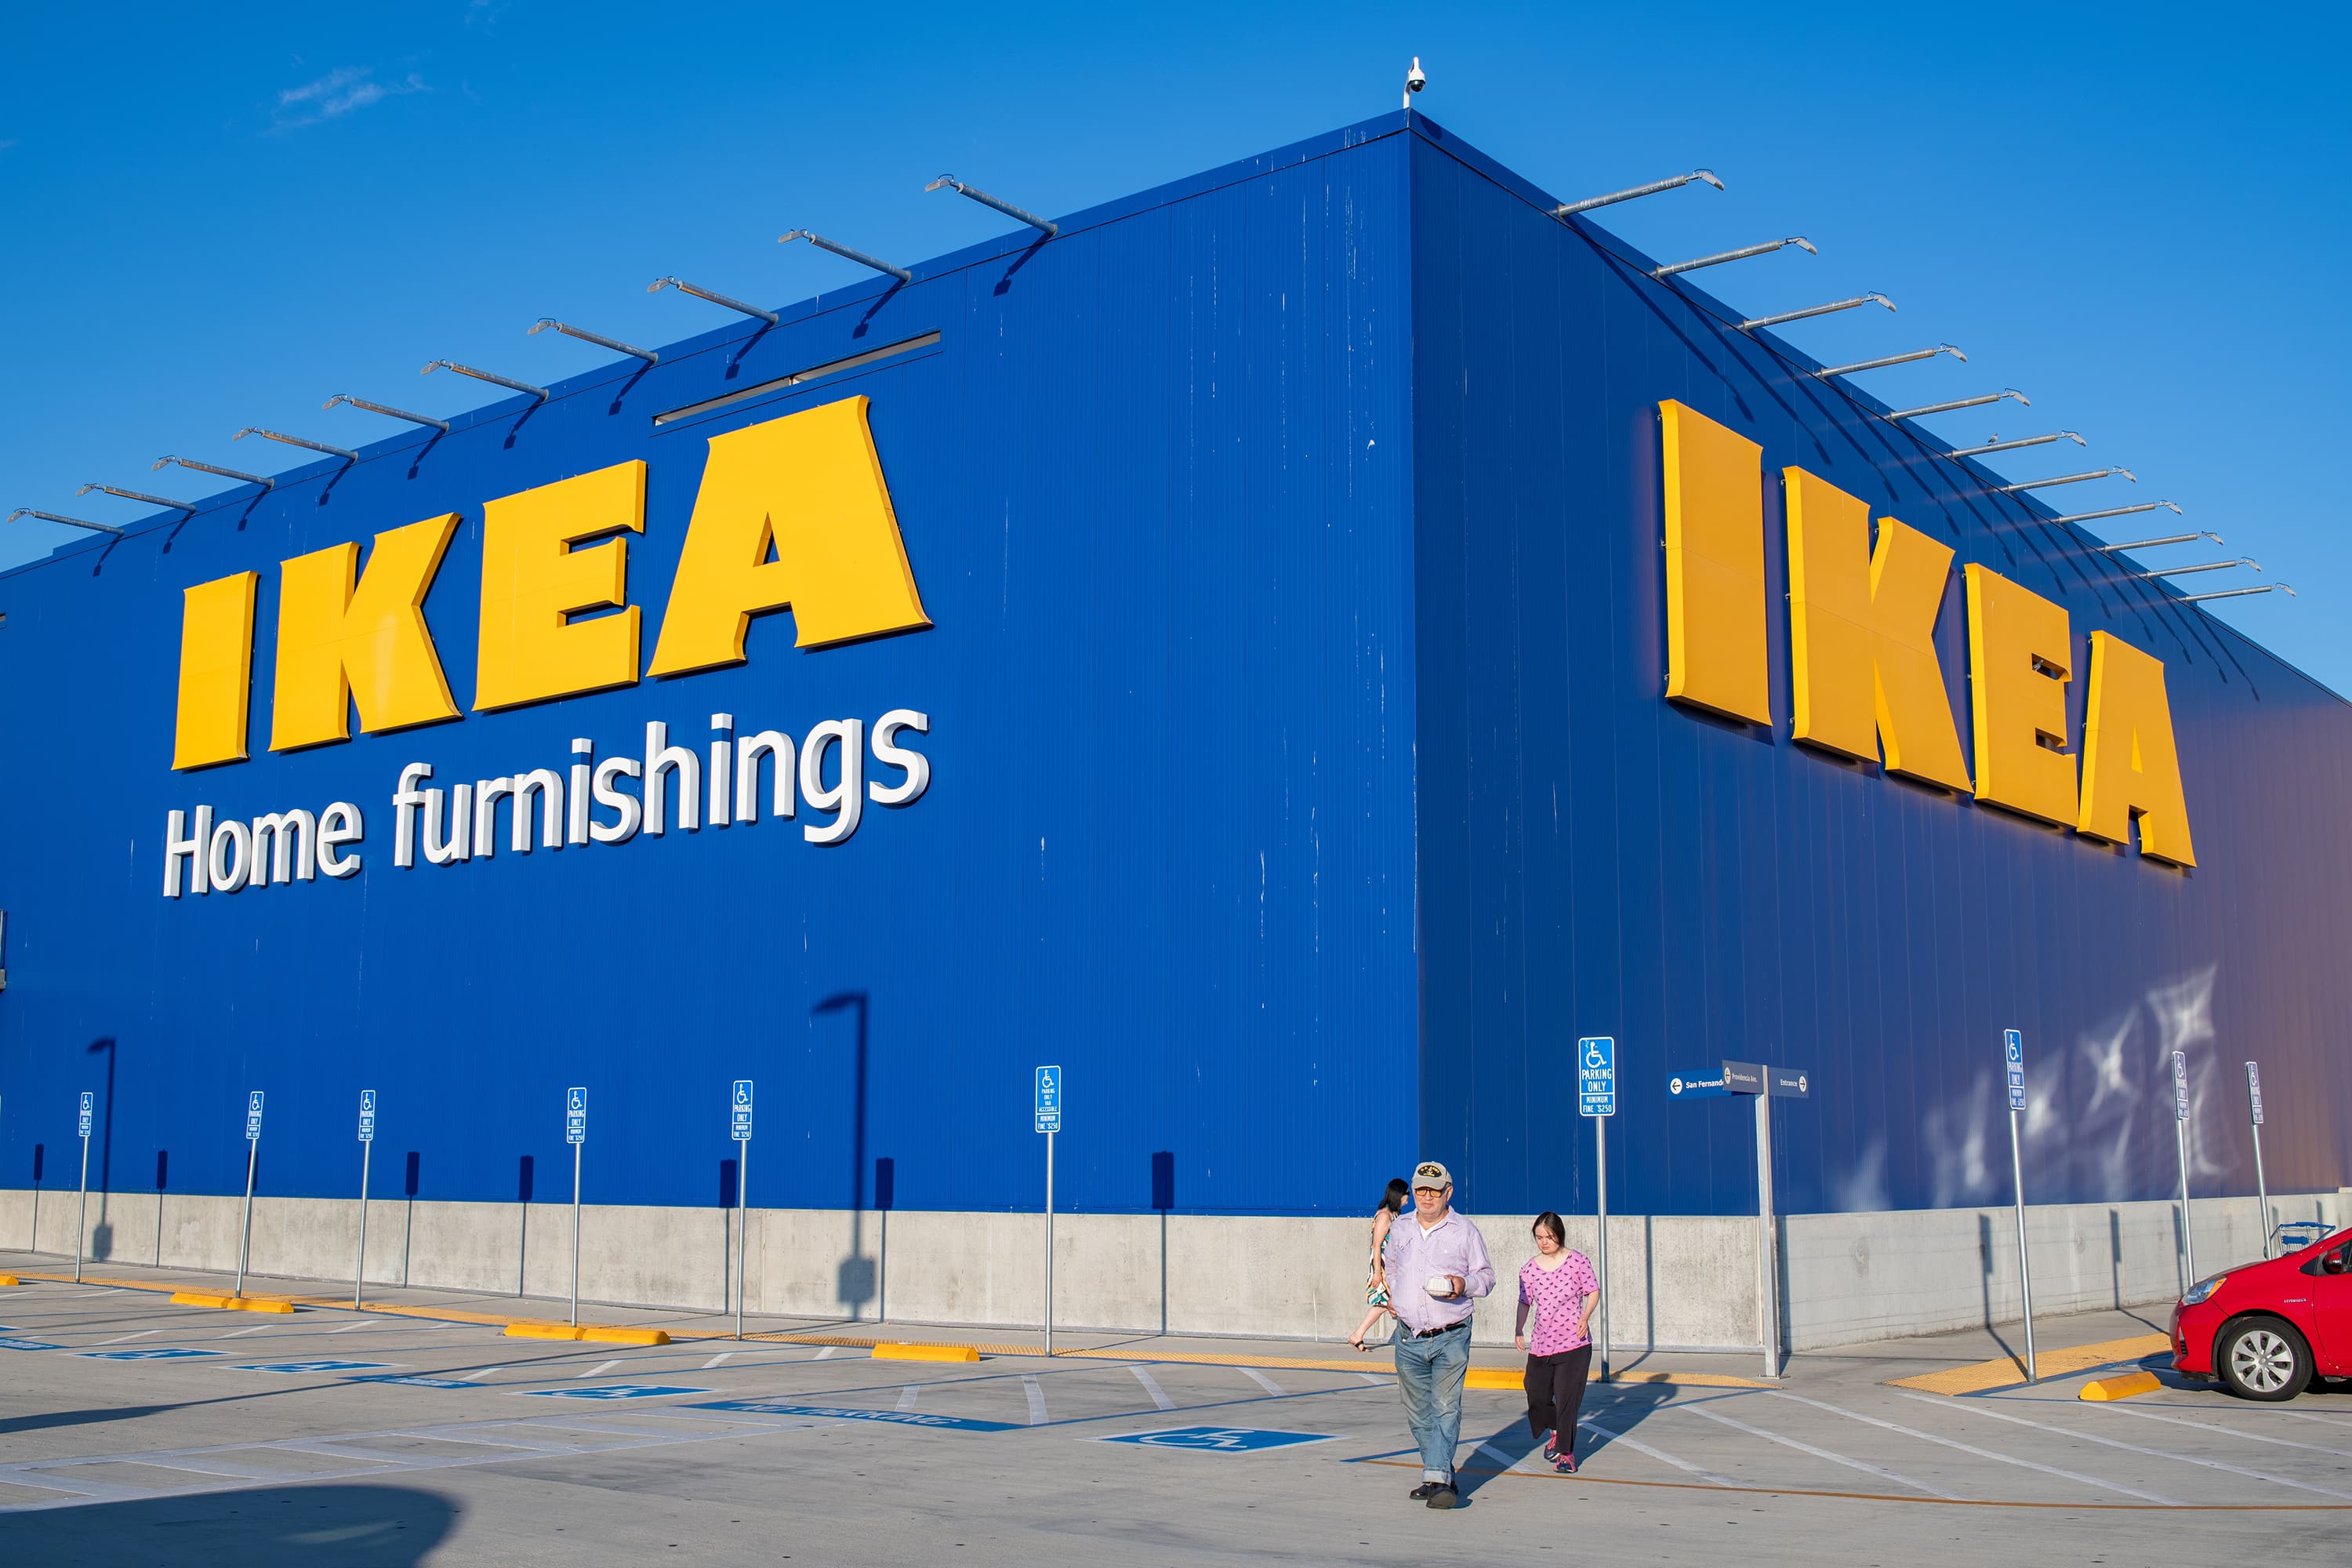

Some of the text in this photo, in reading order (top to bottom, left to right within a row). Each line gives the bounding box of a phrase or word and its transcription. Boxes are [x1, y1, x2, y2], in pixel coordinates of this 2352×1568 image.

[172, 395, 934, 771] IKEA
[1659, 398, 2197, 867] IKEA
[163, 709, 931, 898] Home furnishings
[1582, 1069, 1612, 1080] PARKING
[1588, 1081, 1606, 1092] ONLY
[735, 1104, 750, 1112] PARKING
[790, 1408, 961, 1425] PARKING
